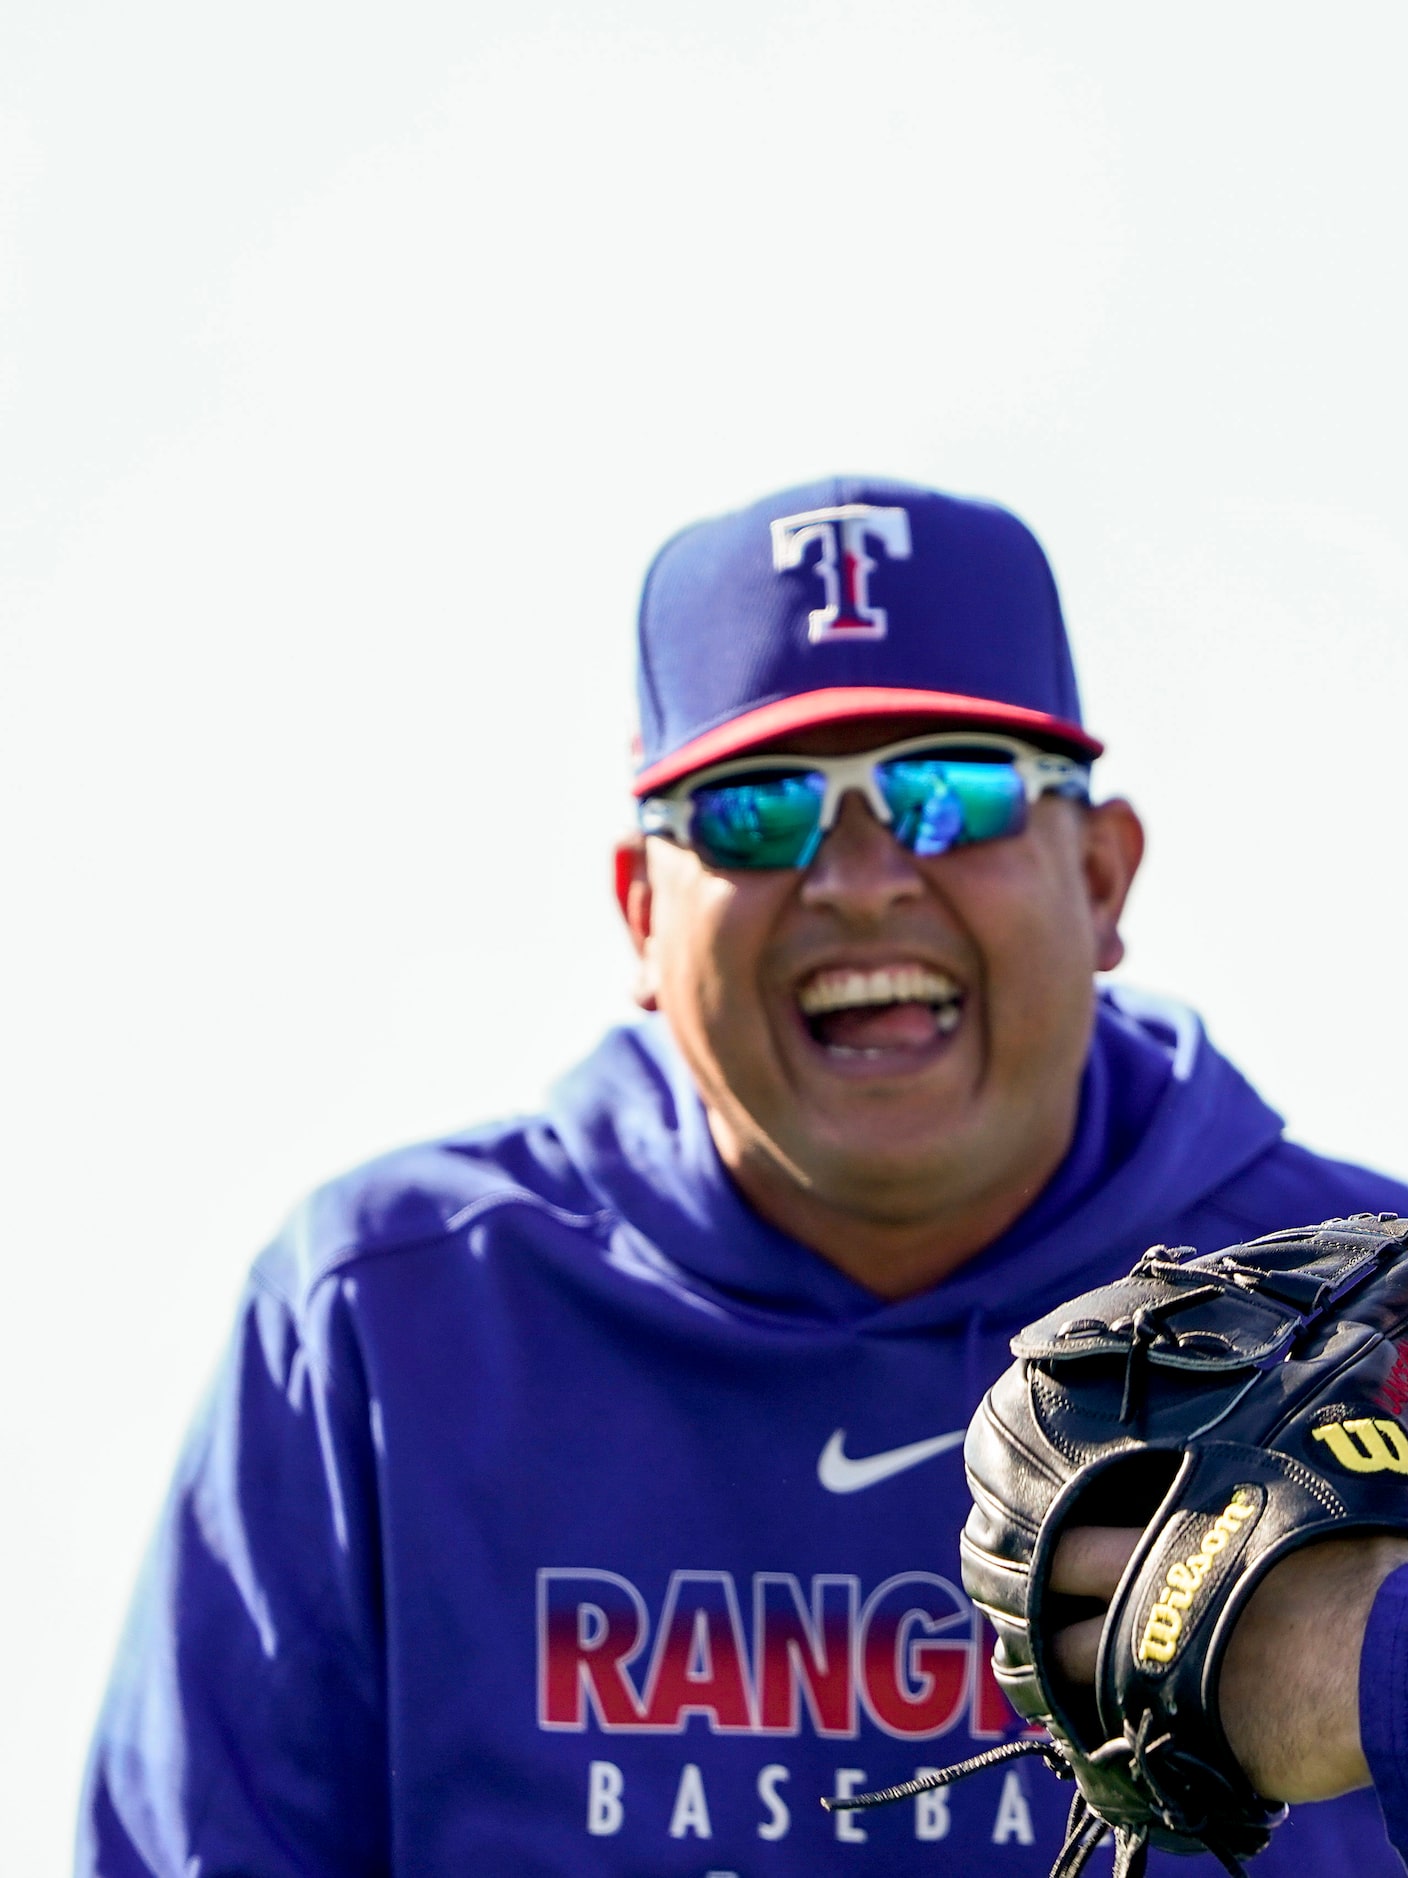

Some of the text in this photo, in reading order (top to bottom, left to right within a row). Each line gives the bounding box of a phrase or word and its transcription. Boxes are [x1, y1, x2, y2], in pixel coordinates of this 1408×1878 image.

[770, 503, 912, 644] T
[537, 1567, 1052, 1741] RANG
[1138, 1490, 1255, 1663] Wilson
[586, 1760, 1112, 1846] BASEBA
